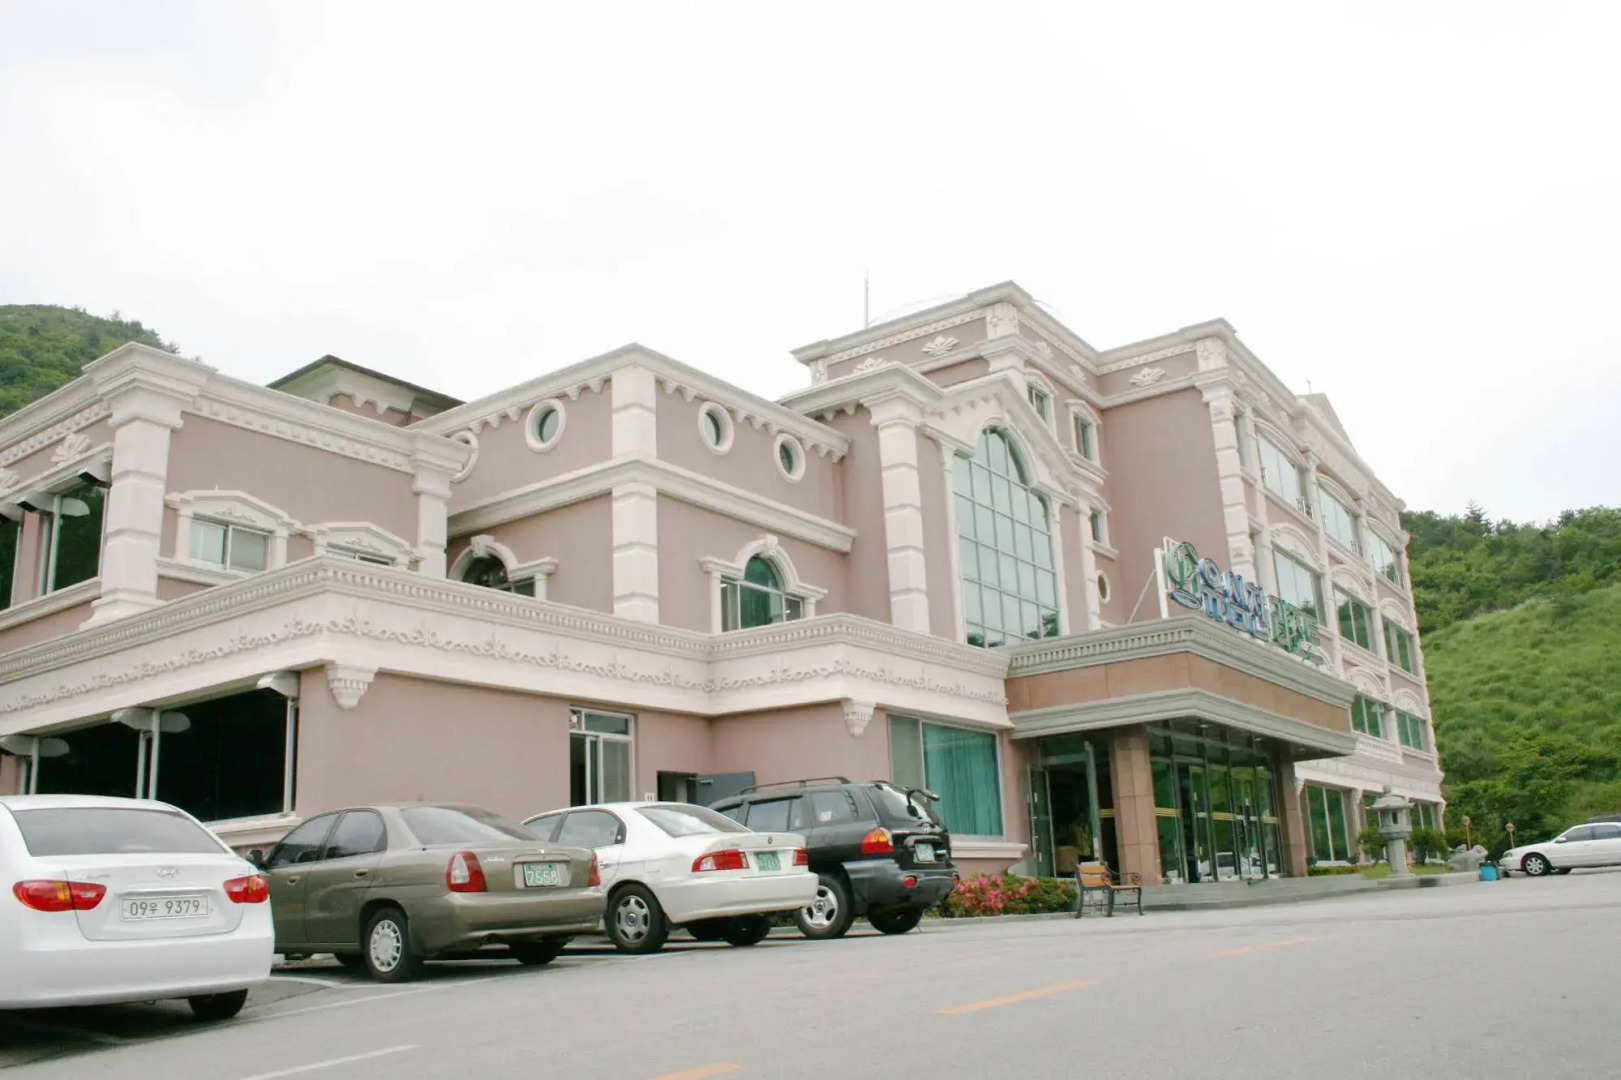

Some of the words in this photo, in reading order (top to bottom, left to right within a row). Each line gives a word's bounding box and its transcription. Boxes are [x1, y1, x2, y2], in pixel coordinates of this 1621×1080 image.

[526, 870, 558, 884] 7558
[129, 901, 158, 916] 09우
[165, 899, 201, 915] 9379
